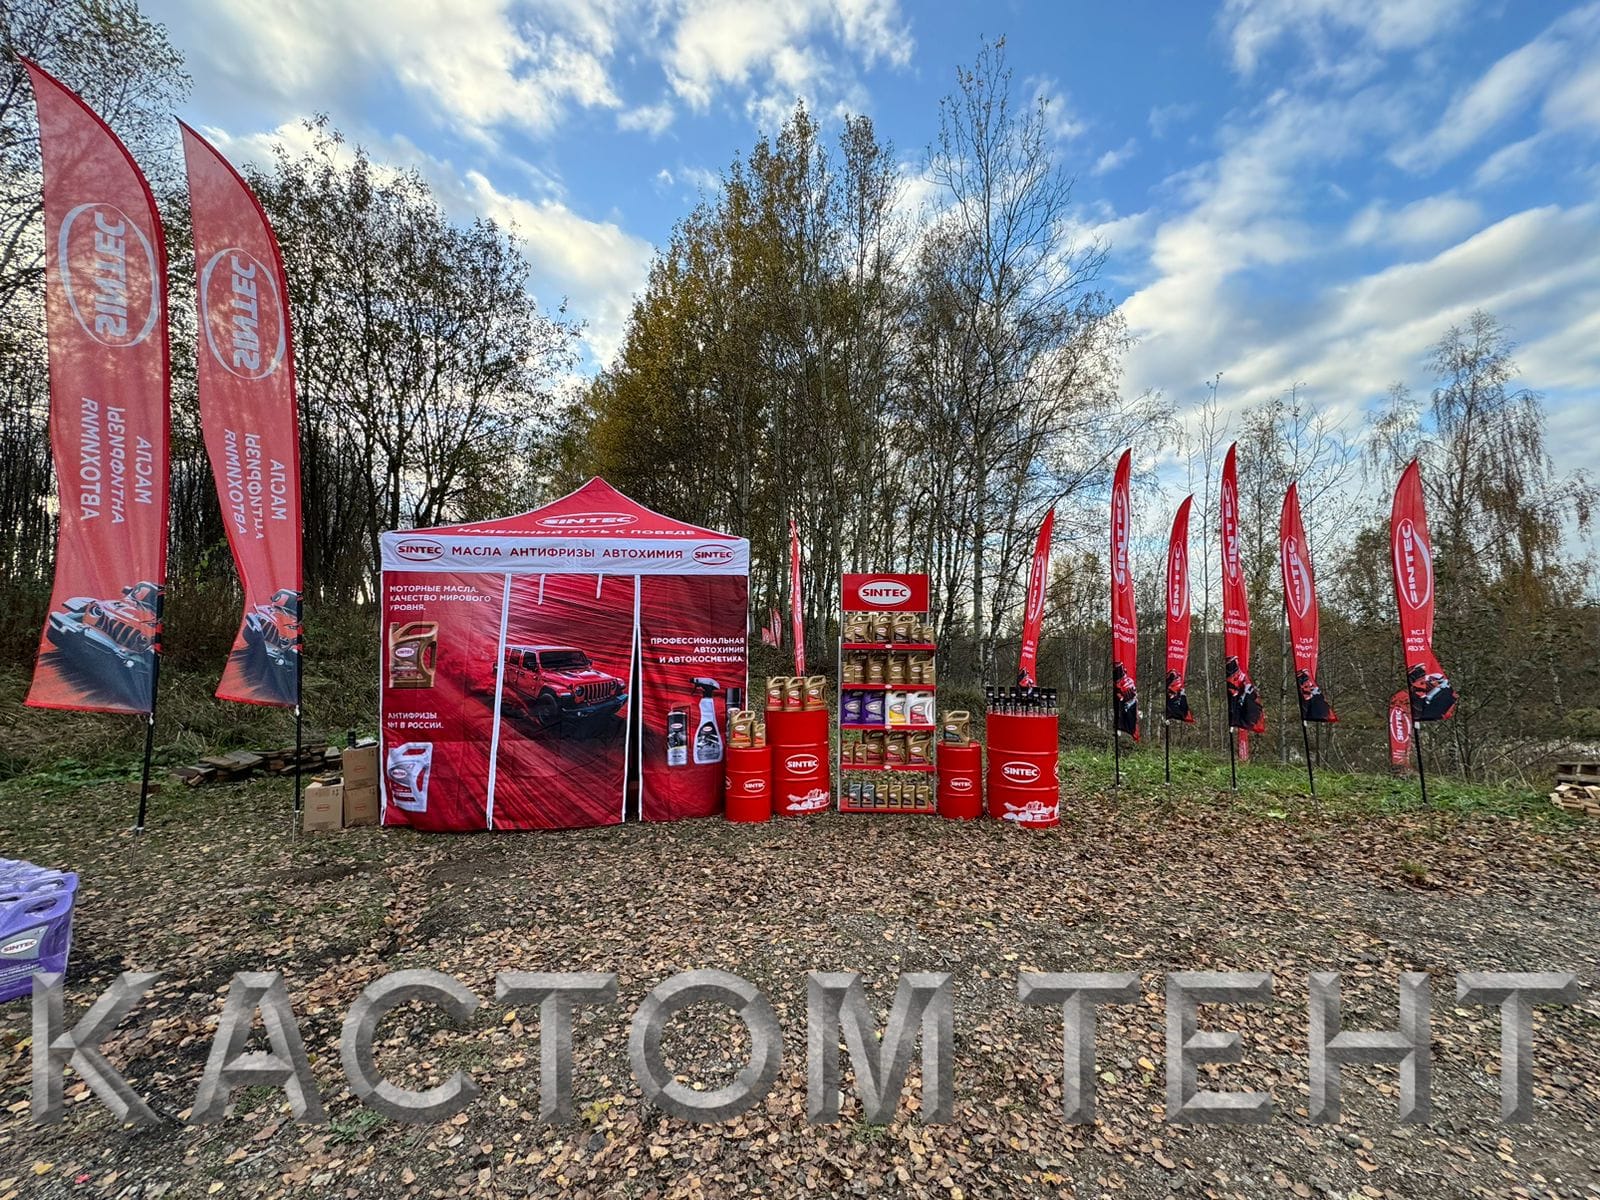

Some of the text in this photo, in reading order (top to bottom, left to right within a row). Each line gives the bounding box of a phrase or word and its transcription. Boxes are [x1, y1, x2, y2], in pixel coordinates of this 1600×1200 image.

[541, 516, 632, 526] SINTEC
[398, 545, 441, 555] SINTEC
[451, 546, 683, 559] МАСЛА АНТИФРИЗЫ АВТОХИМИЯ
[694, 551, 732, 559] SINTEC
[862, 588, 907, 598] SINTEC
[439, 594, 492, 602] МИРОВОГО
[650, 637, 745, 645] ПРОФЕССИОНАЛЬНАЯ
[693, 646, 745, 654] АВТОХИМИЯ
[659, 655, 745, 664] И АВТОКОСМЕТИКА.
[387, 712, 437, 720] АНТИФРИЗЫ
[407, 721, 444, 729] РОССИИ.
[786, 759, 818, 769] SINTEC
[1003, 766, 1038, 777] SINTEC
[3, 940, 36, 952] SINTEC
